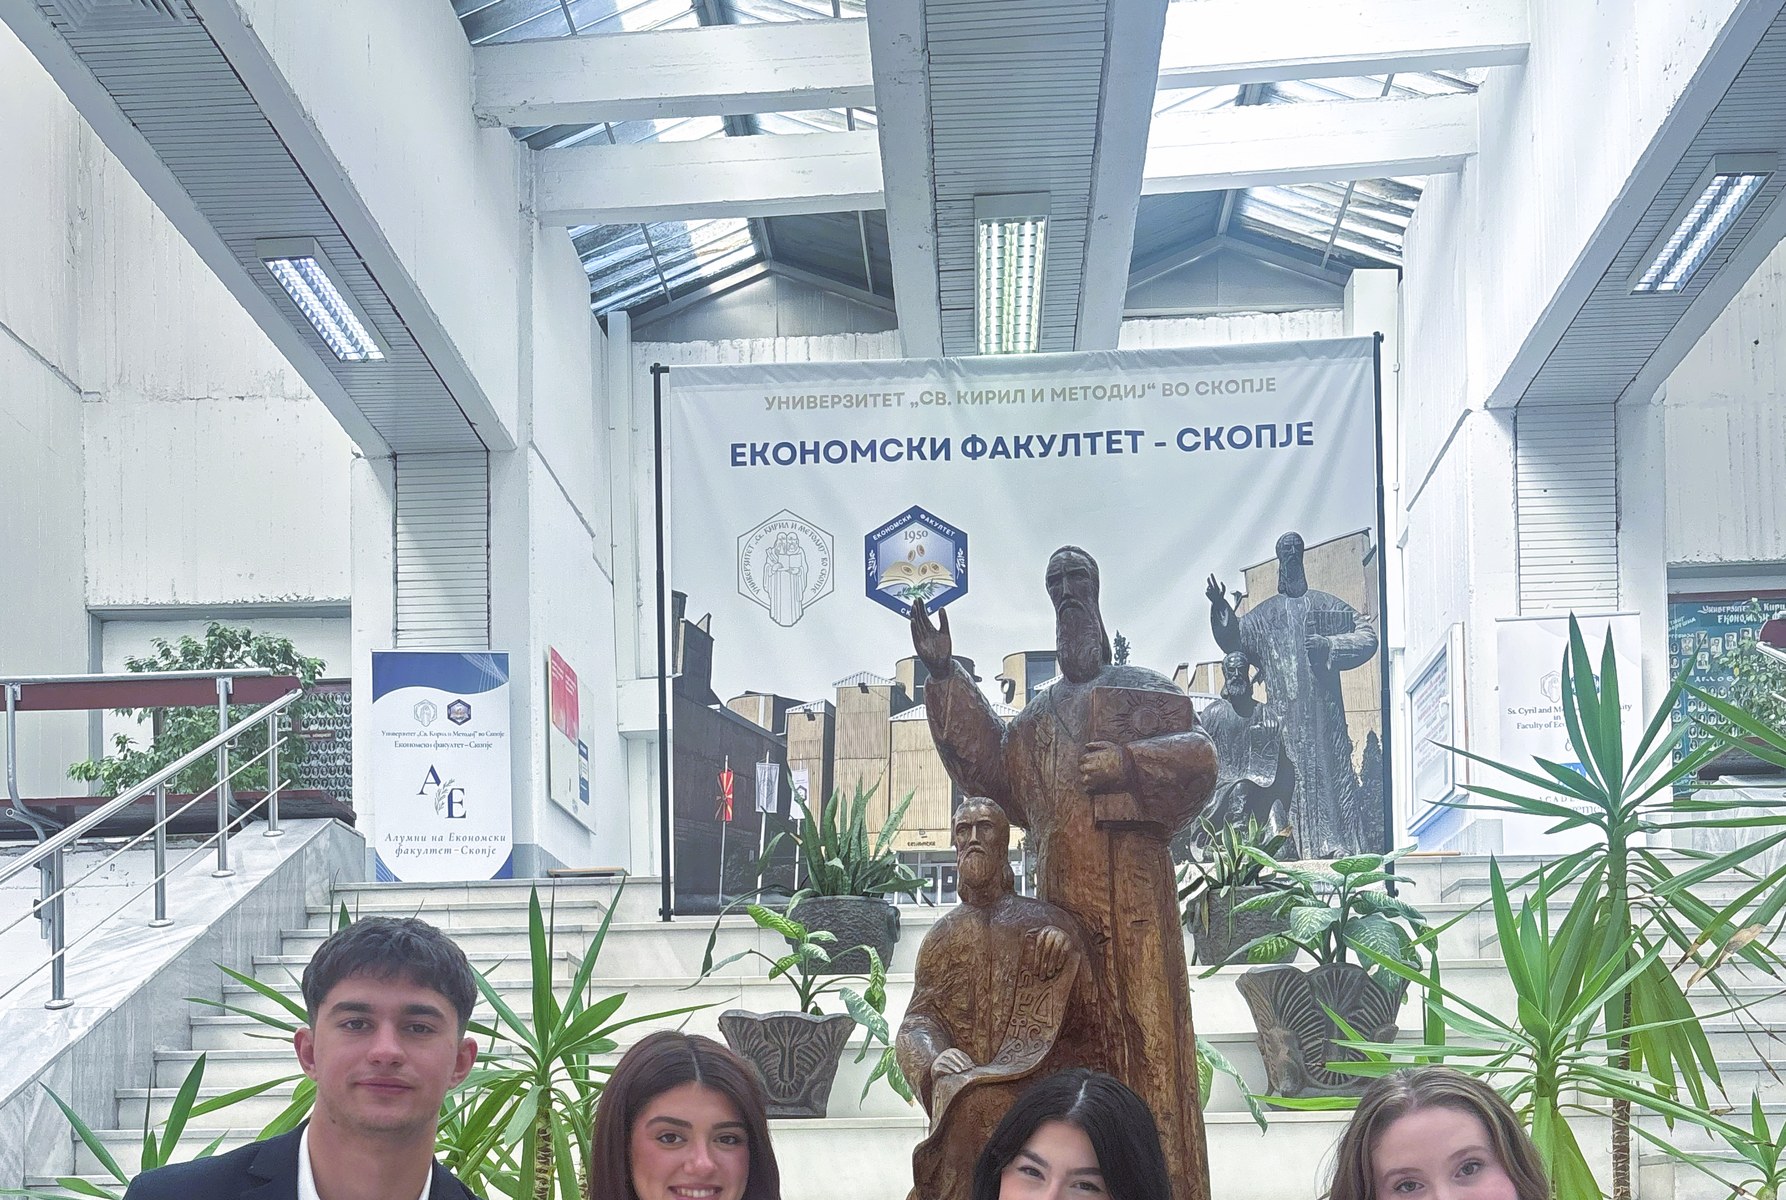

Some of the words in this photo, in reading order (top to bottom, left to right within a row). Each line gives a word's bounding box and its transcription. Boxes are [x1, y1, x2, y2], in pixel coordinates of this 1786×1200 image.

[764, 392, 905, 411] УНИВЕРЗИТЕТ
[910, 390, 952, 409] „СВ.
[957, 388, 1026, 406] КИРИЛ
[1031, 388, 1045, 403] И
[1050, 383, 1156, 403] МЕТОДИЈ“
[1162, 381, 1190, 397] ВО
[1194, 377, 1276, 396] СКОПЈЕ
[730, 436, 951, 467] ЕКОНОМСКИ
[960, 430, 1145, 461] ФАКУЛТЕТ
[1176, 421, 1314, 452] СКОПЈЕ
[872, 514, 912, 541] ЕКОНОМСКИ
[919, 513, 956, 537] ФАКУЛТЕТ
[904, 530, 929, 544] 1950
[1518, 706, 1537, 716] Cyril
[1537, 706, 1552, 714] and
[1516, 721, 1543, 730] Faculty
[1544, 720, 1552, 729] of
[394, 741, 432, 749] Економски
[385, 832, 427, 846] Алумни
[431, 834, 444, 842] на
[448, 832, 507, 842] Економски
